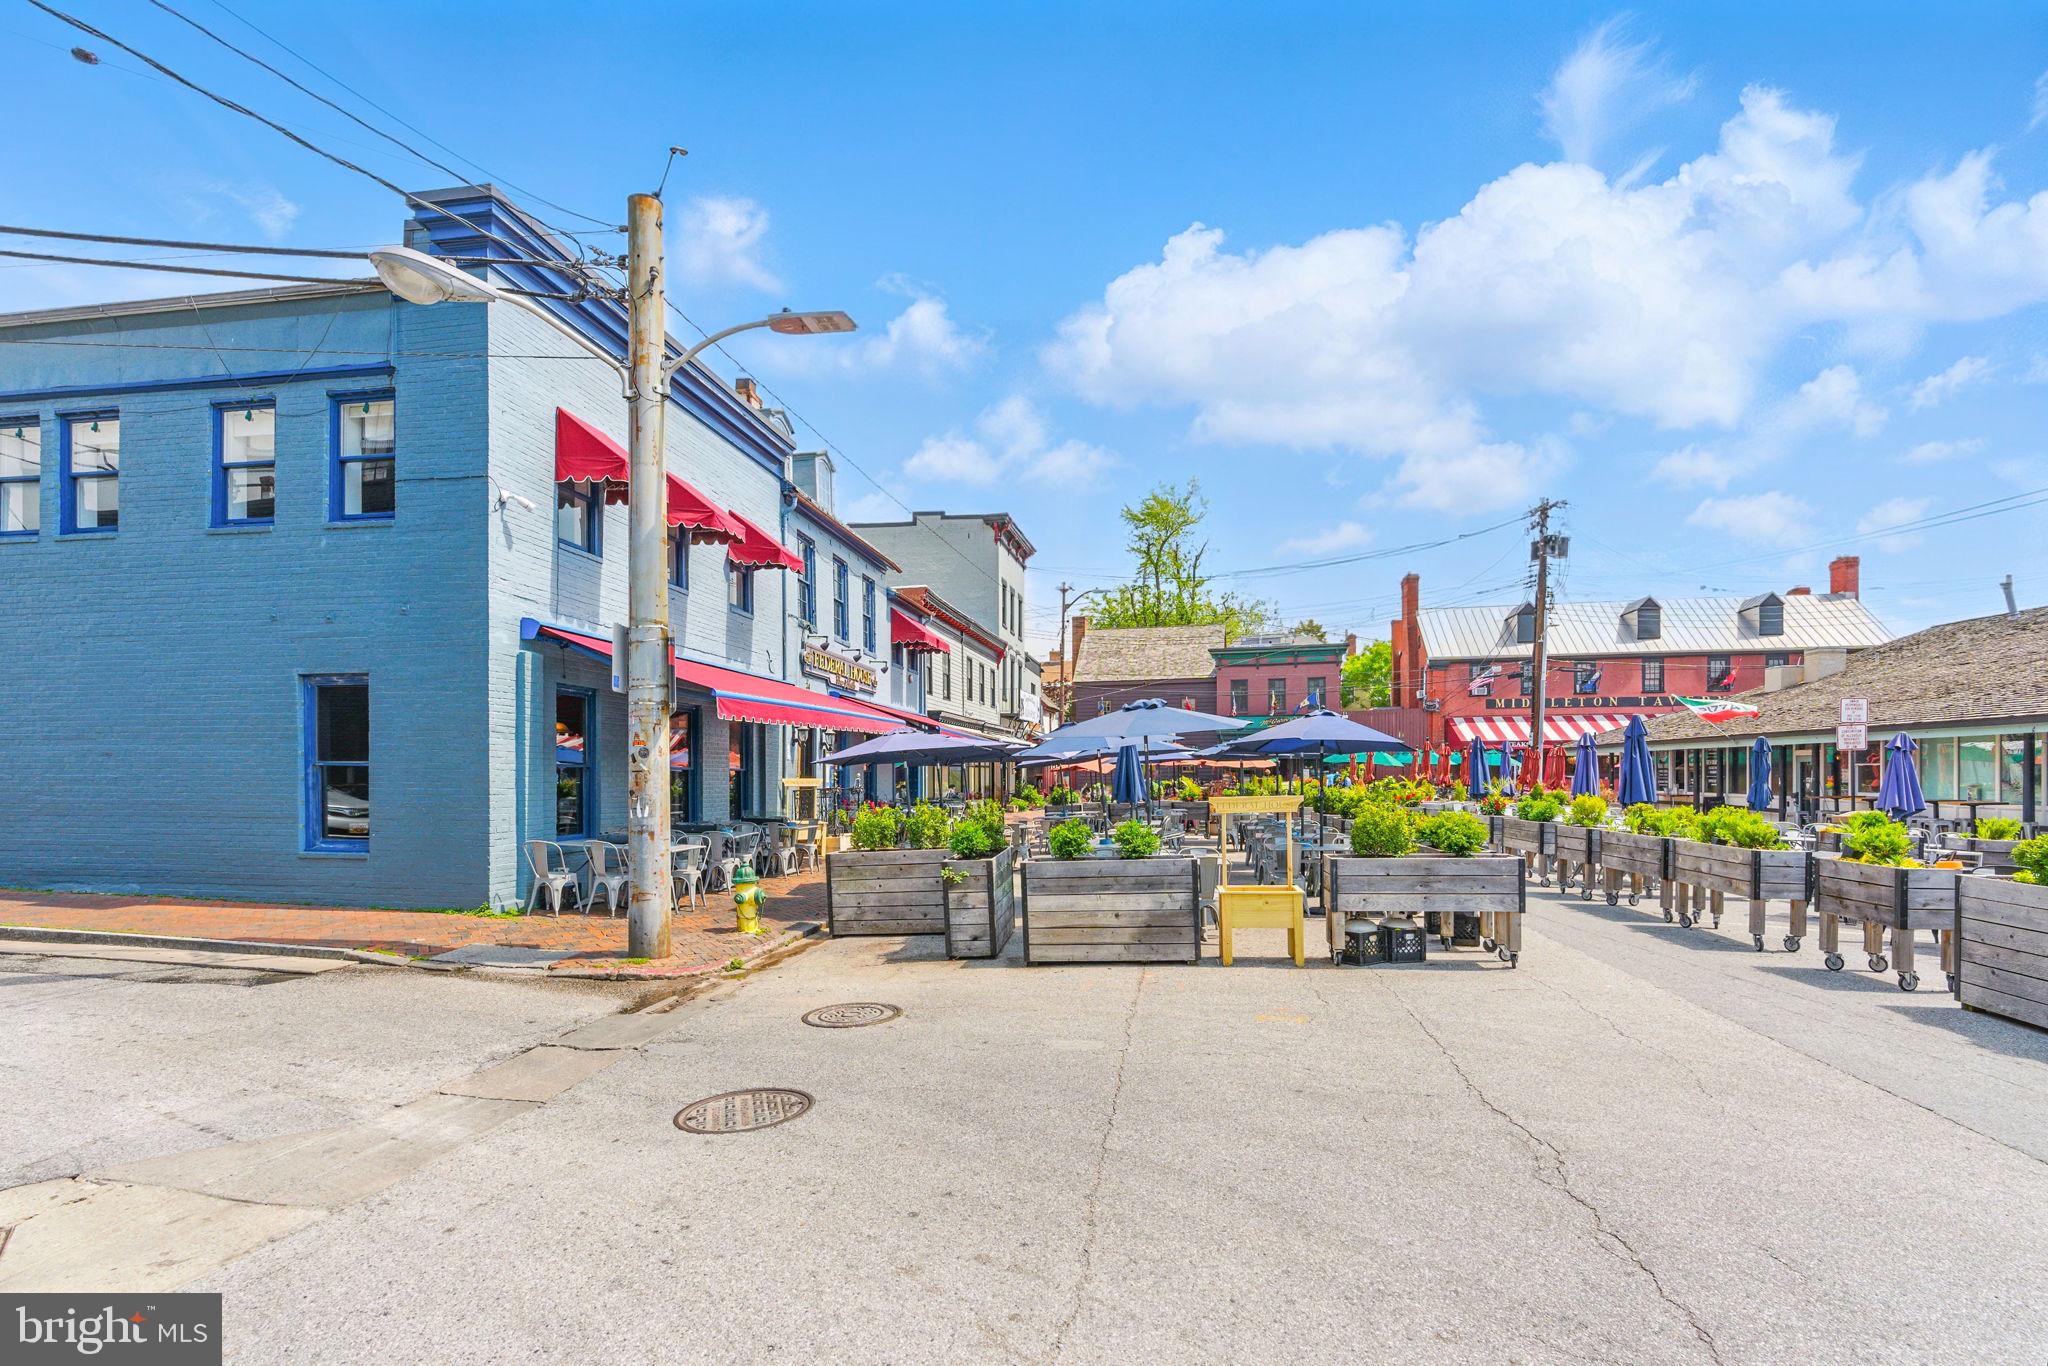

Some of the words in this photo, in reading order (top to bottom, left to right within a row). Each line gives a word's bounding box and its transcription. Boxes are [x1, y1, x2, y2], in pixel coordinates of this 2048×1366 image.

[813, 652, 848, 676] FEDERAL
[849, 664, 872, 685] HOUSE
[1495, 697, 1618, 708] MIDLETON
